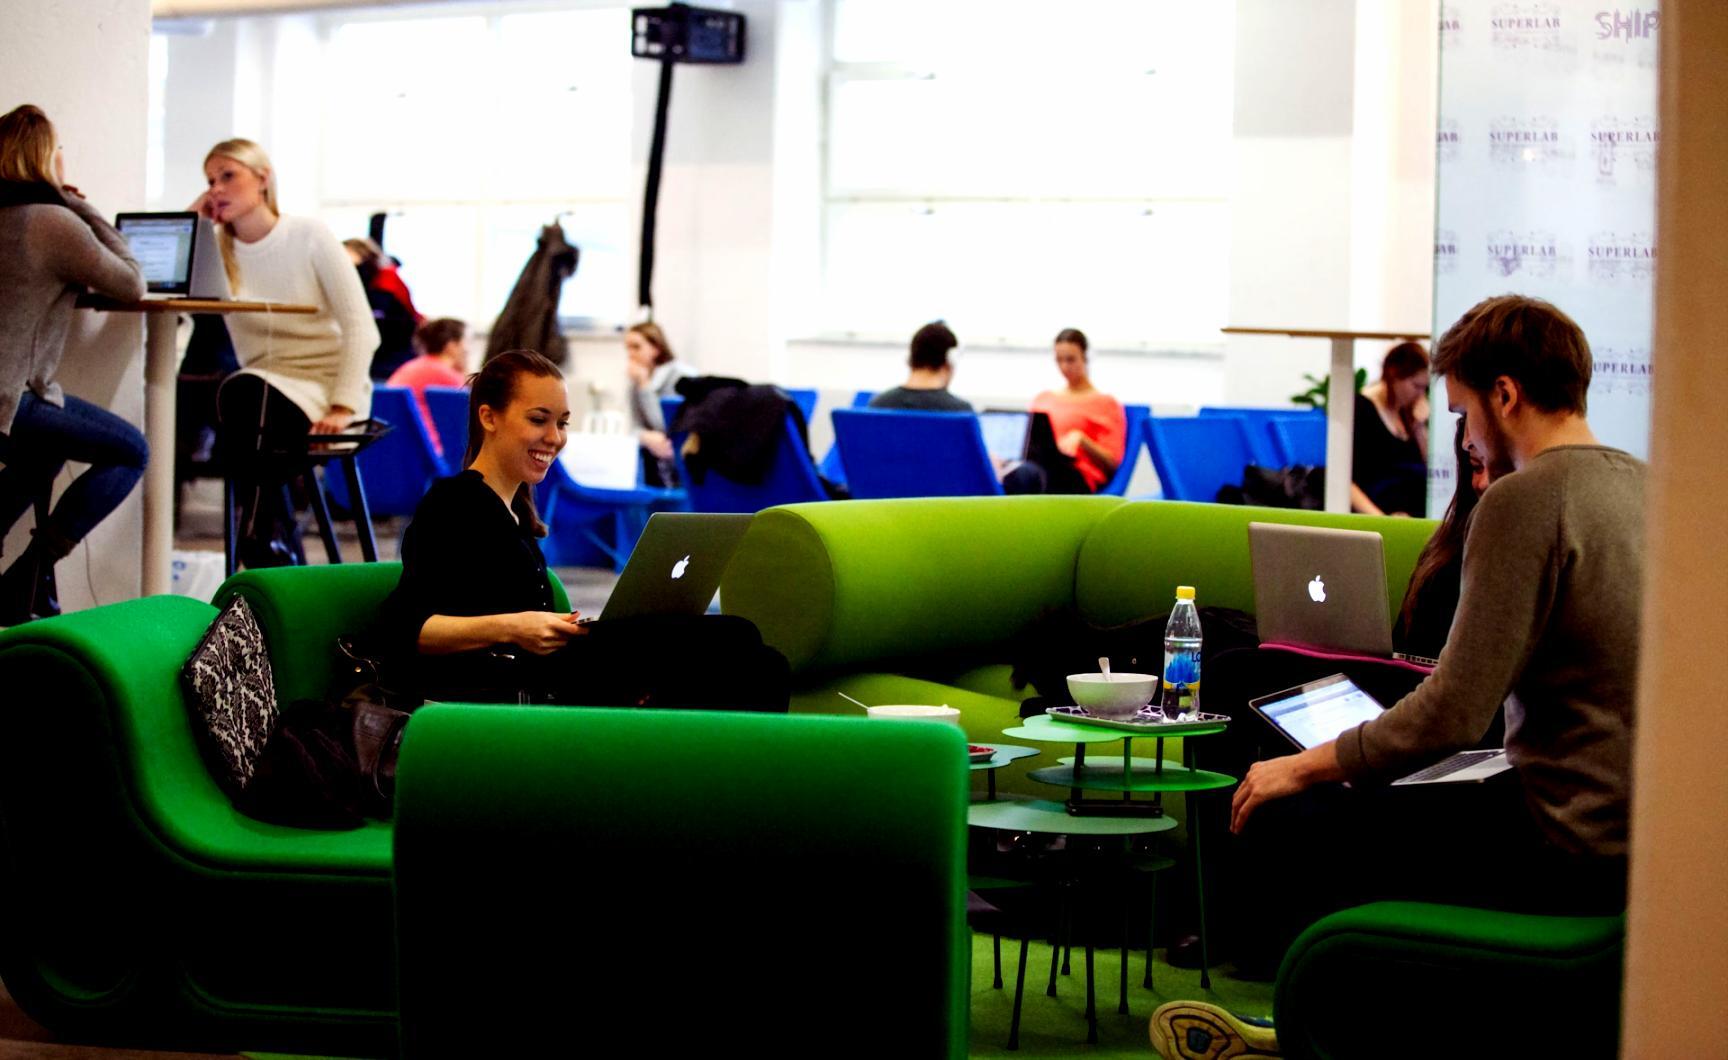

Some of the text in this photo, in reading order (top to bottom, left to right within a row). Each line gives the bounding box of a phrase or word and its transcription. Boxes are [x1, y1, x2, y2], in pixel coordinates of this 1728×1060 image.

[1491, 18, 1561, 29] SUPERLAB
[1489, 131, 1559, 143] SUPERLAB
[1487, 245, 1556, 256] SUPERLAB
[1593, 362, 1654, 375] UPERLAB
